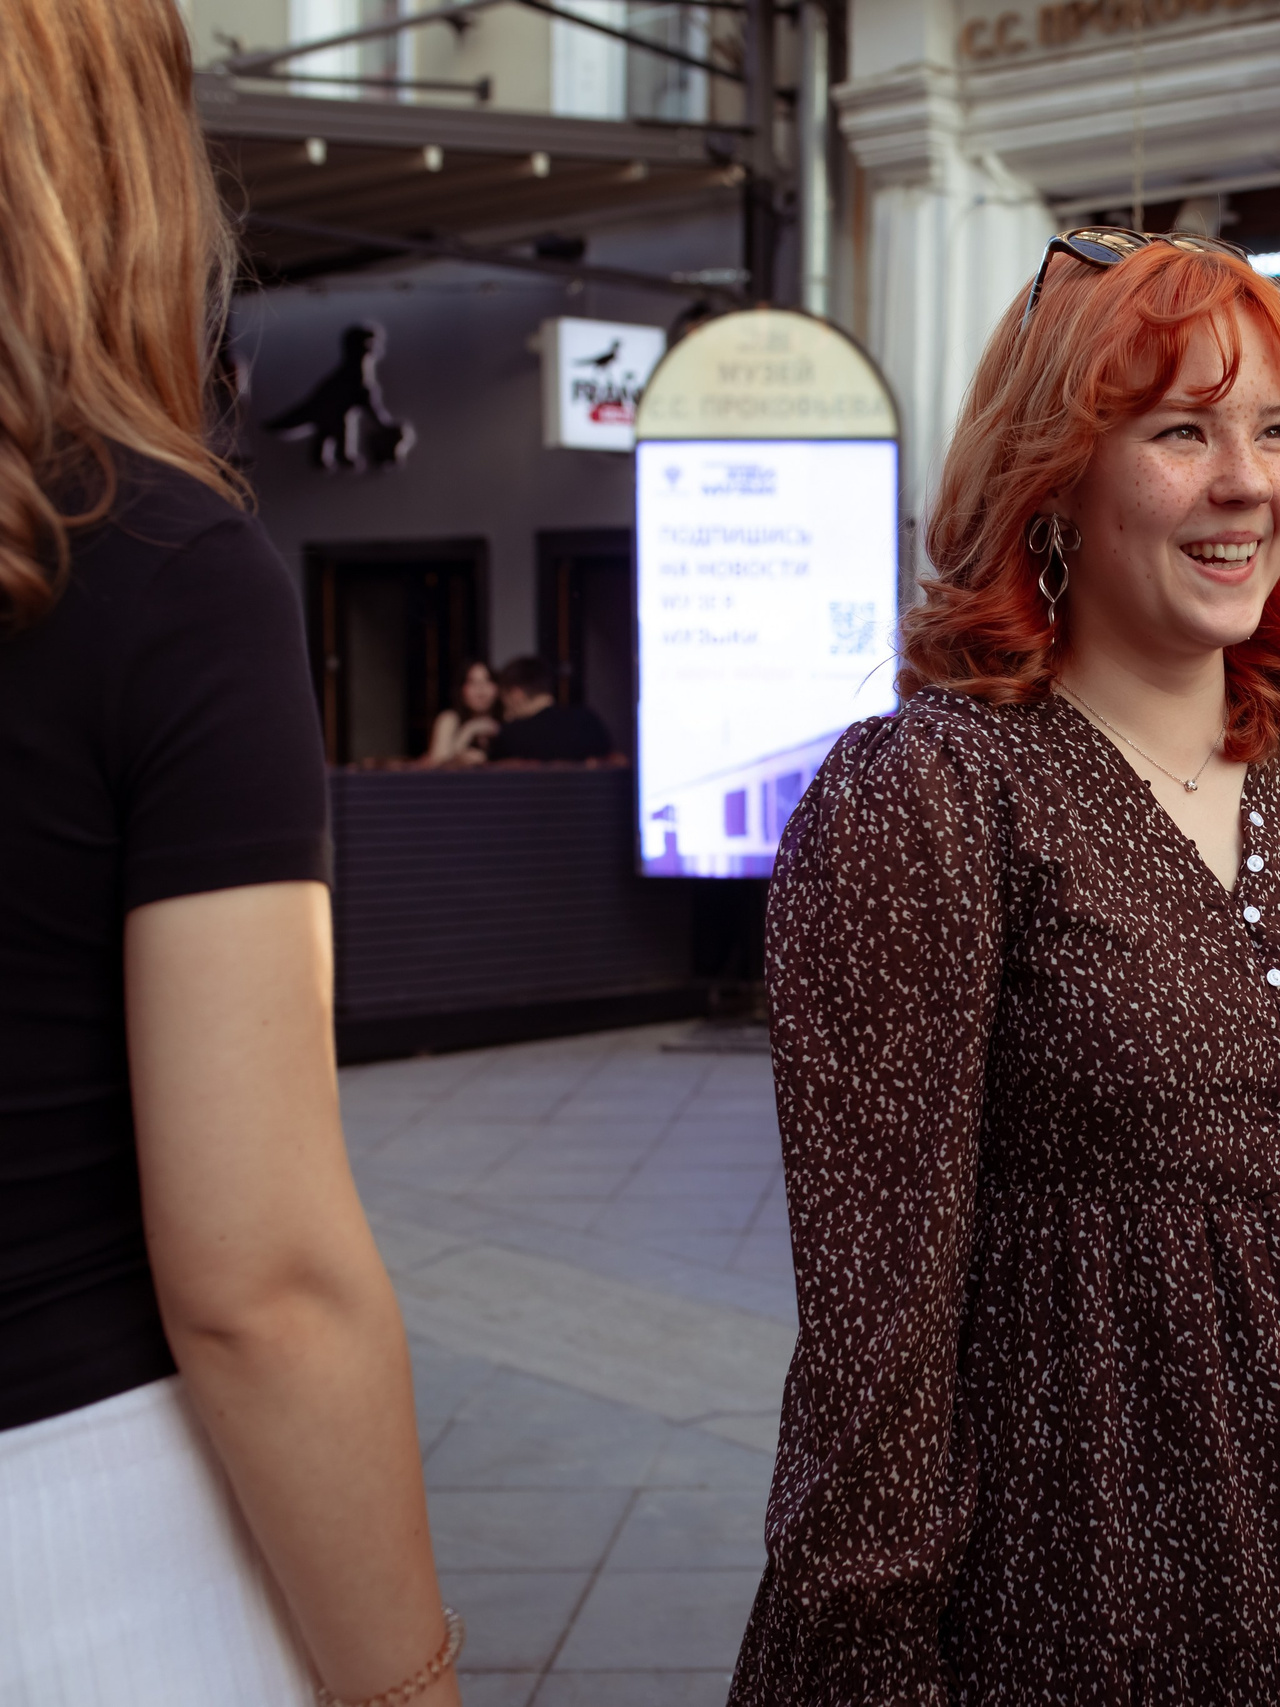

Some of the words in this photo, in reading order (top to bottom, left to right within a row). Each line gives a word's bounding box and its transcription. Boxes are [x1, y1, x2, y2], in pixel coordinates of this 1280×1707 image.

[716, 353, 815, 384] МУЗЕЙ
[699, 393, 889, 418] ПРОКОФЬЕВА
[659, 525, 813, 547] ПОДПИШИСЬ
[696, 560, 810, 578] НОВОСТИ
